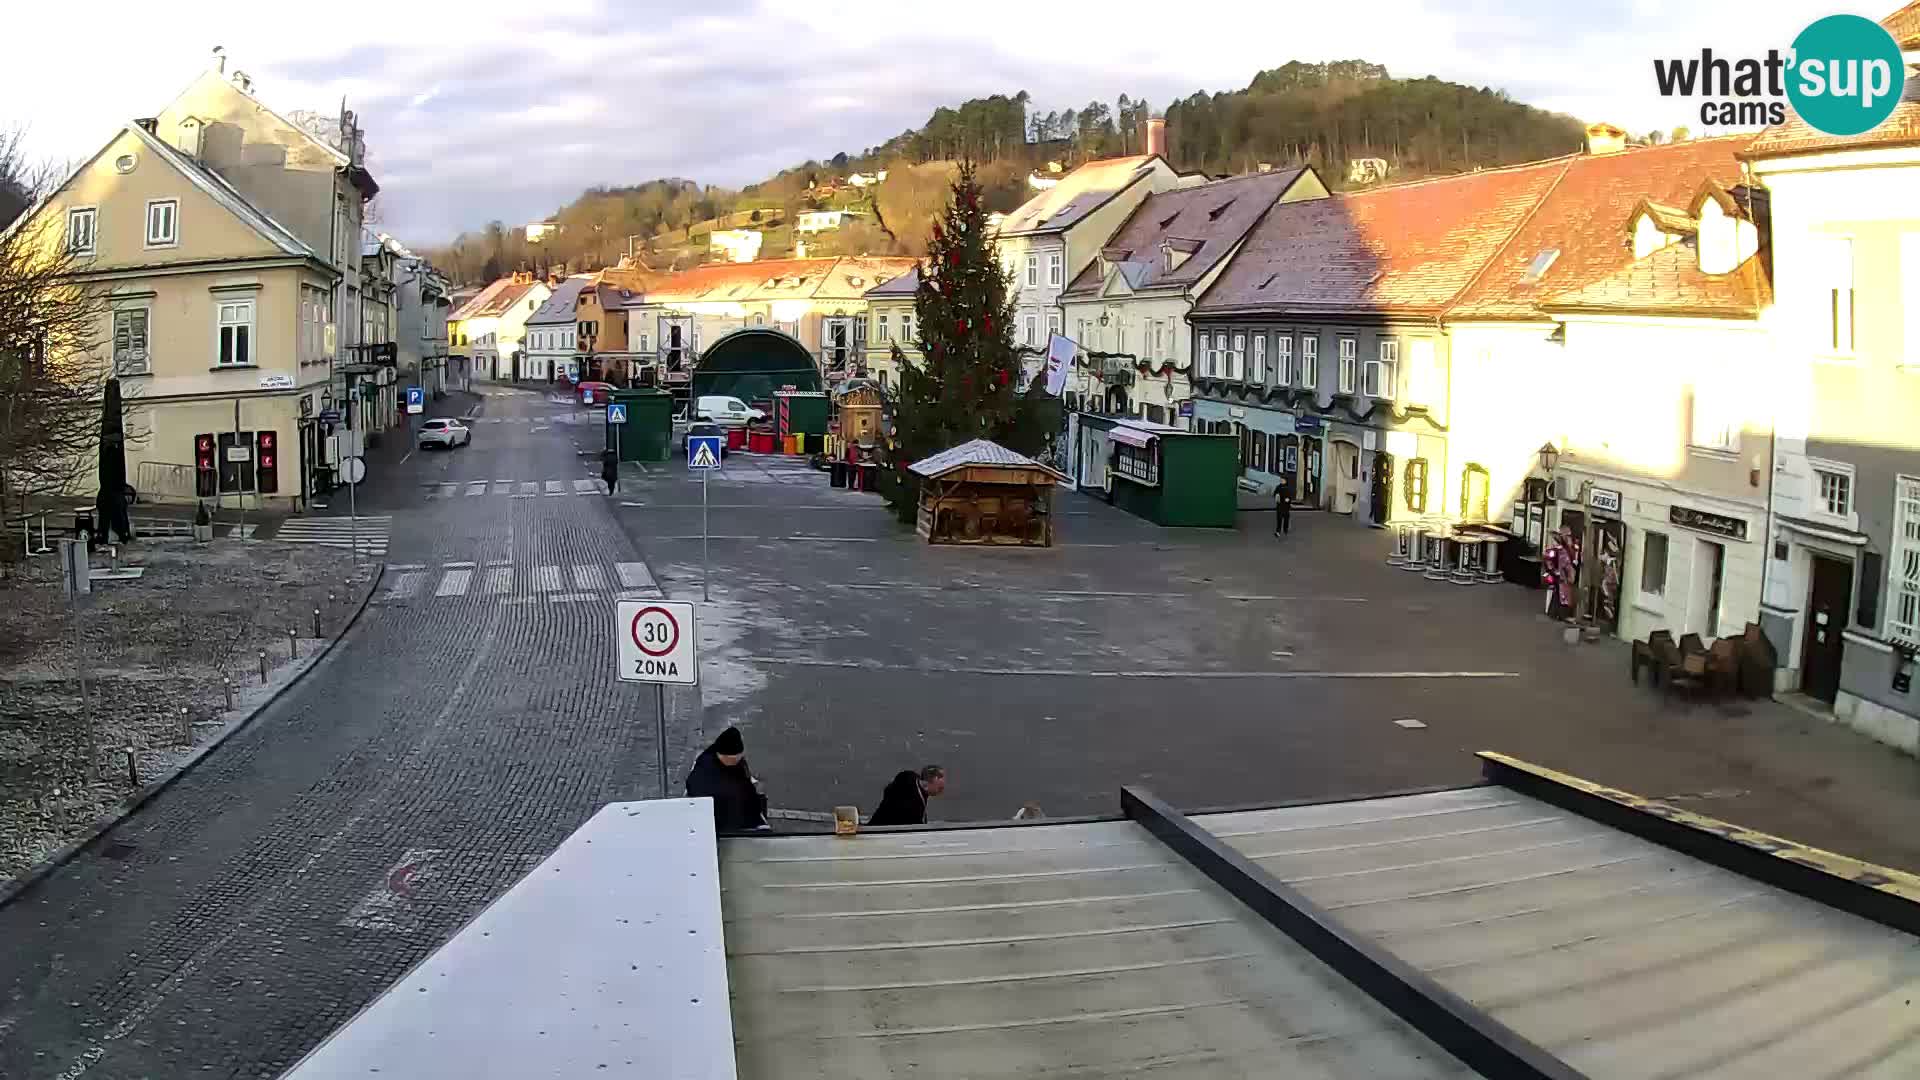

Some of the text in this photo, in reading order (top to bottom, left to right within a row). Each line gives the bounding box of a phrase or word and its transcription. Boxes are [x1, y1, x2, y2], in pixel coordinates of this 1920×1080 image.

[411, 391, 419, 403] P
[644, 622, 667, 642] 30
[635, 660, 678, 676] ZONA
